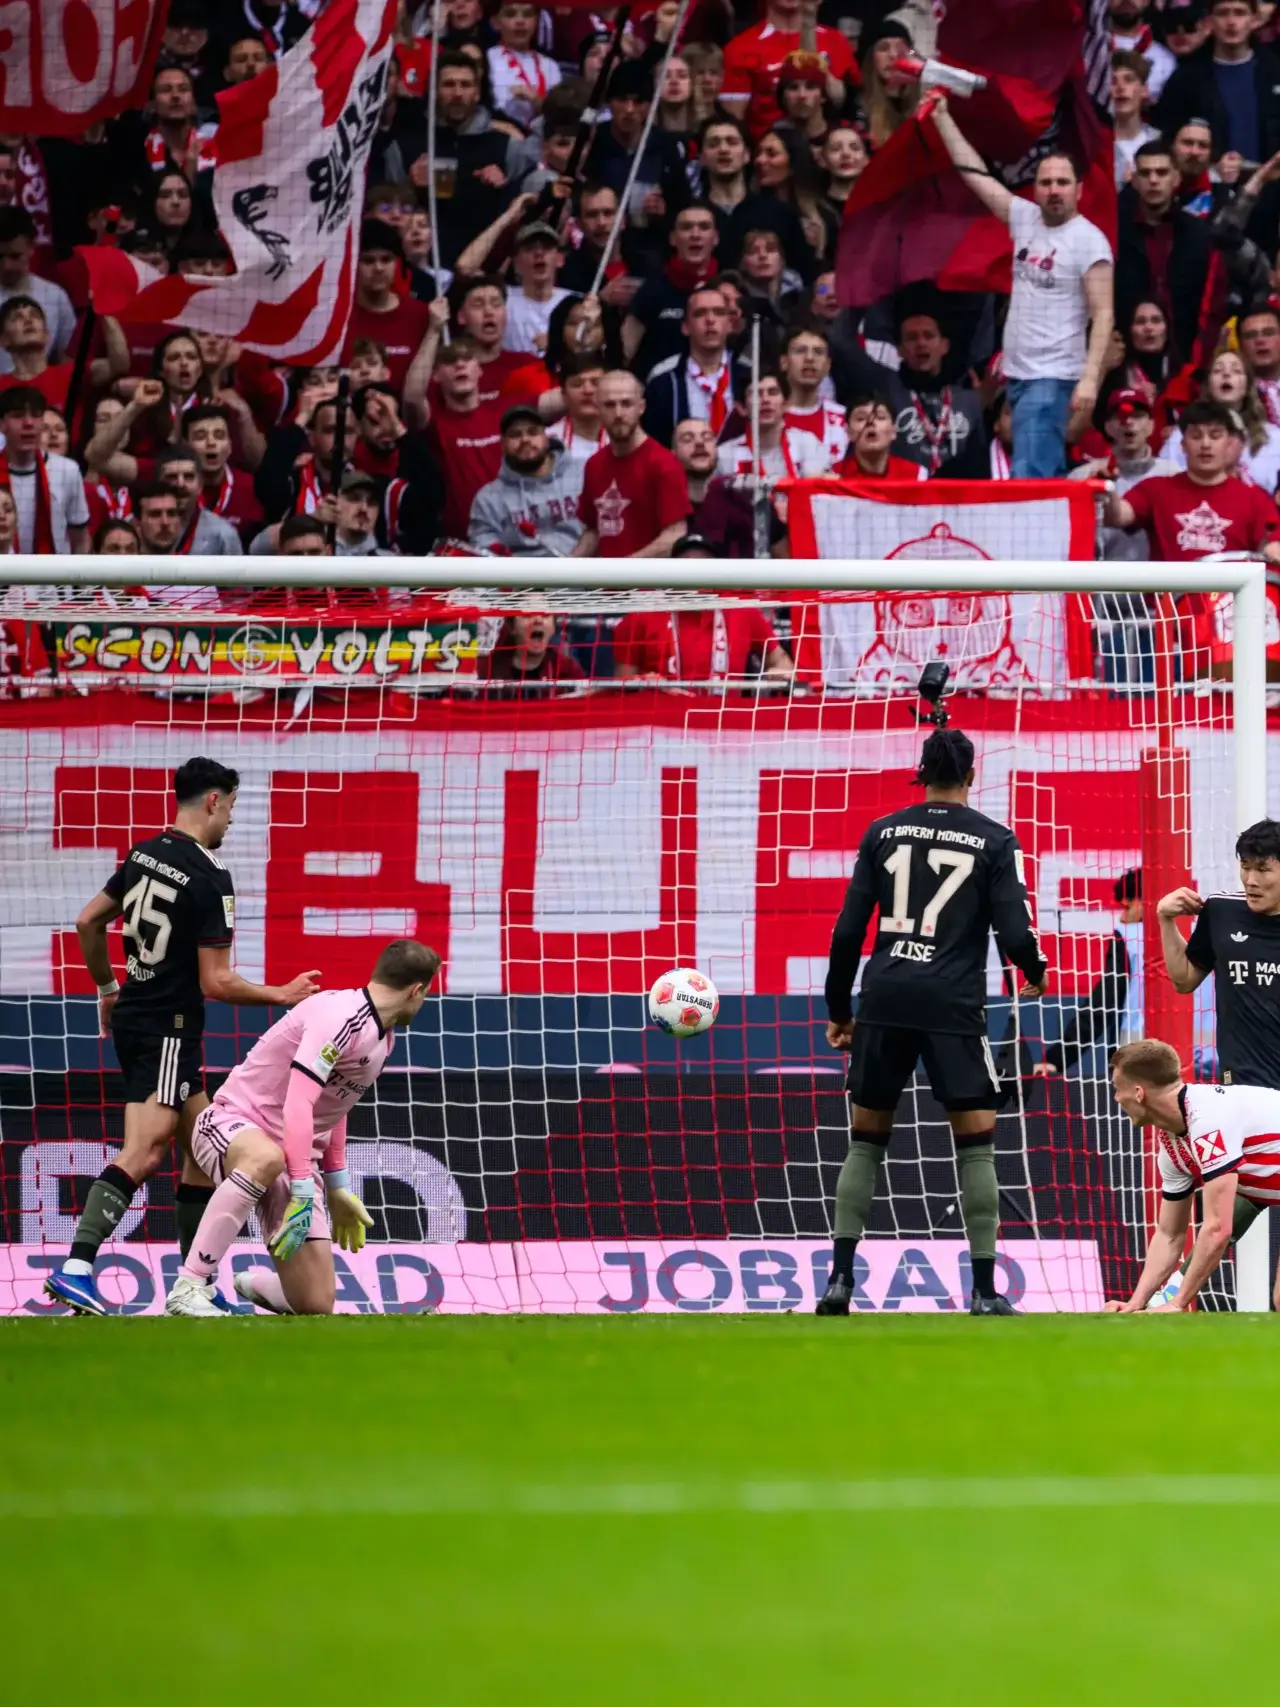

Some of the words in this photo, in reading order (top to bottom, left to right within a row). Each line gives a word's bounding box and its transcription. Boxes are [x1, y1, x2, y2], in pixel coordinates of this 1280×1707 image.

[291, 627, 472, 676] VOLTS
[880, 827, 895, 839] FC
[895, 824, 935, 841] BAYERN
[879, 844, 976, 938] 17
[890, 940, 936, 963] OLISE
[1256, 973, 1274, 987] TV
[676, 992, 713, 1011] DERBYSTAR
